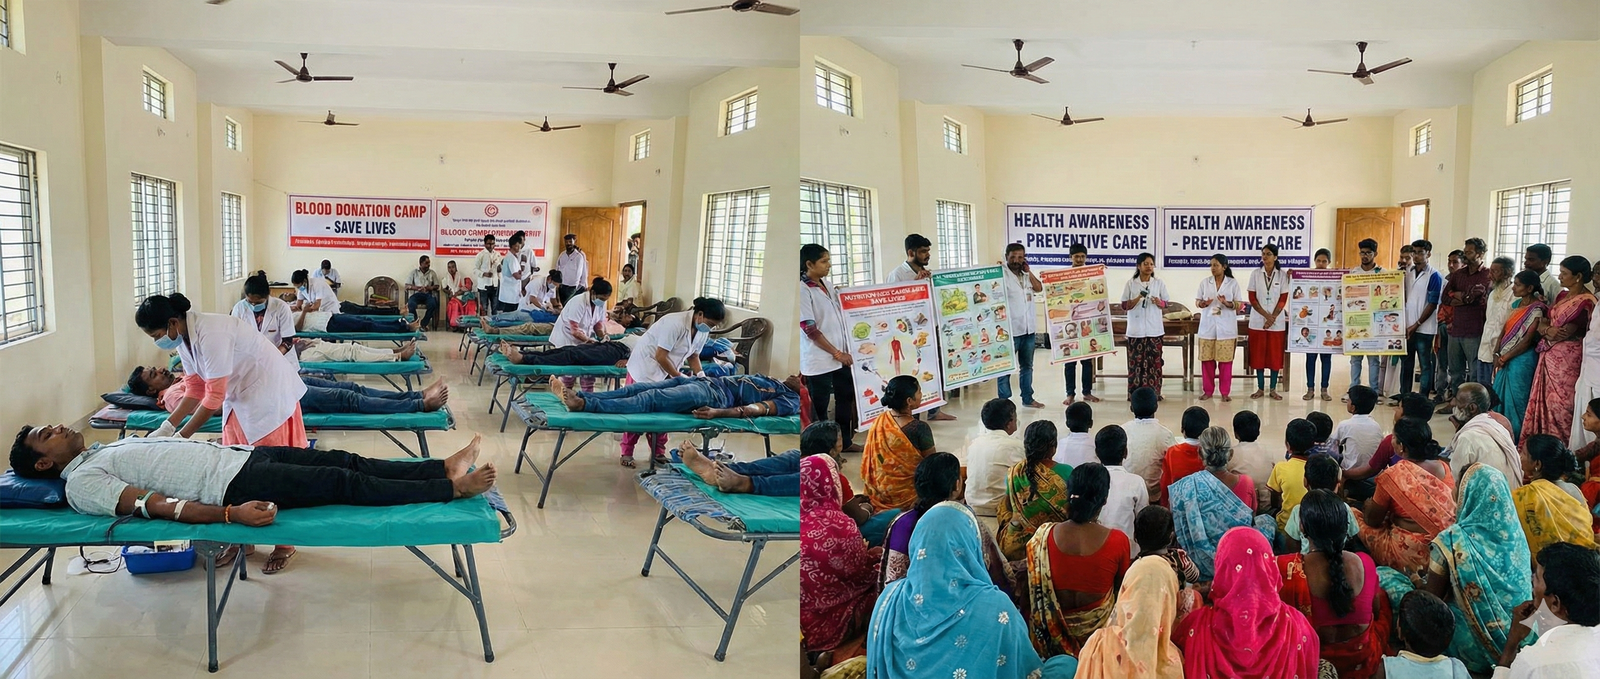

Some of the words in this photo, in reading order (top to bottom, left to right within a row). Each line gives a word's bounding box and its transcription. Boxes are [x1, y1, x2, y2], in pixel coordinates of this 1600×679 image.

[295, 201, 332, 216] BLOOD
[336, 203, 391, 218] DONATION
[394, 205, 427, 218] CAMP
[334, 220, 362, 234] SAVE
[365, 221, 396, 235] LIVES
[1014, 212, 1064, 228] HEALTH
[1069, 213, 1149, 230] AWARENESS
[1171, 215, 1220, 230] HEALTH
[1224, 215, 1305, 230] AWARENESS
[1026, 233, 1108, 249] PREVENTIVE
[1112, 235, 1147, 250] CARE
[1182, 235, 1263, 250] PREVENTIVE
[1267, 235, 1302, 250] CARE
